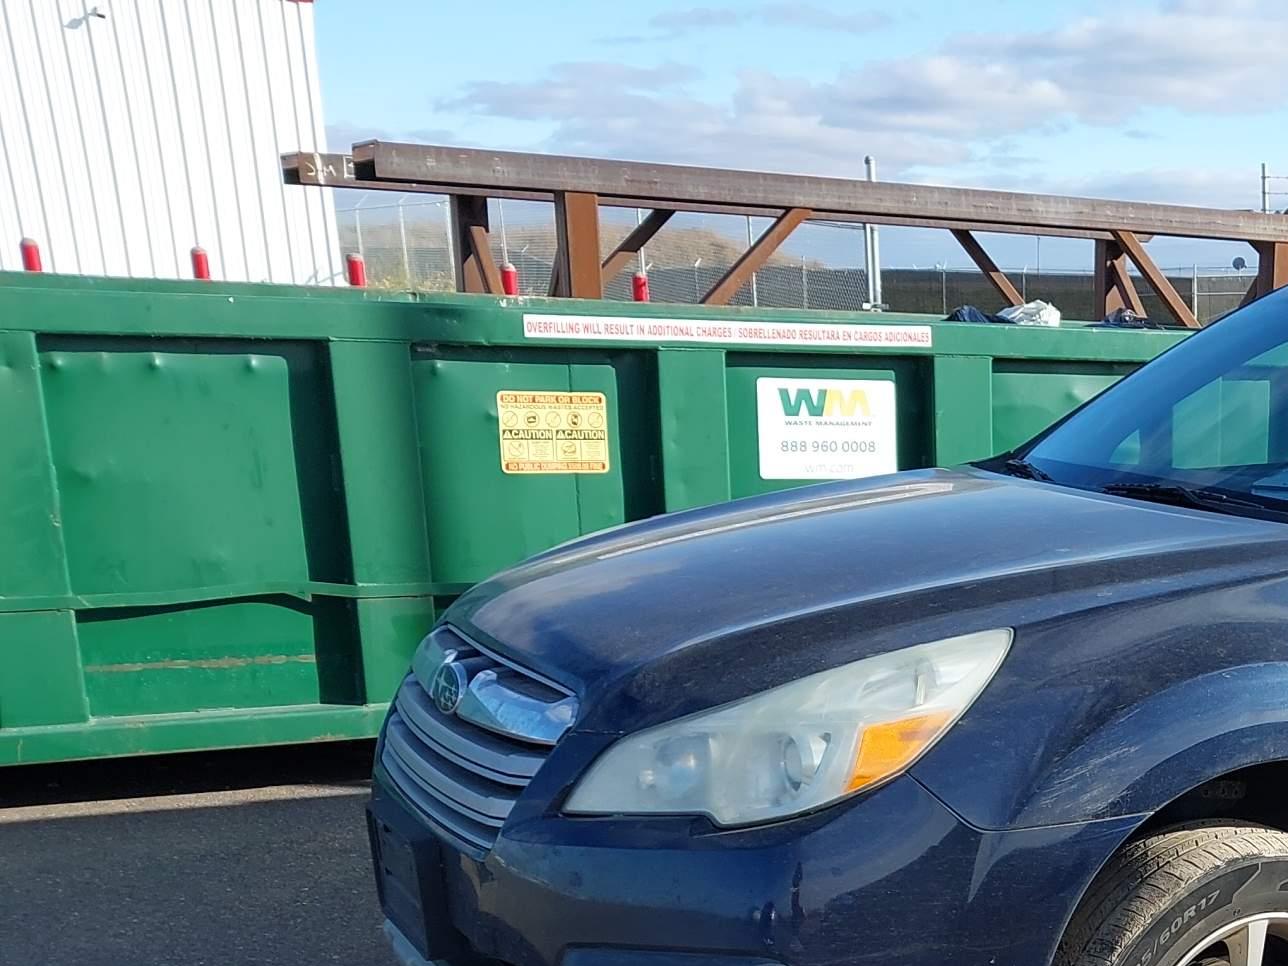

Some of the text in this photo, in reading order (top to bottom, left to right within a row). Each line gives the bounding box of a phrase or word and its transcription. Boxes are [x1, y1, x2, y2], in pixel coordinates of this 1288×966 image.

[527, 322, 580, 335] OVERFILLING
[582, 323, 602, 335] WILL
[604, 324, 634, 336] RESULT
[637, 325, 645, 336] IN
[648, 325, 694, 337] ADDITIONAL
[697, 326, 732, 338] CHARGES
[738, 327, 797, 340] SOBRELLENADO
[842, 331, 852, 341] EN
[854, 331, 882, 342] CARGOS
[885, 331, 930, 343] ADICIONALES
[503, 395, 515, 403] DO
[516, 395, 533, 403] NOT
[558, 396, 571, 404] OR
[572, 396, 600, 404] BLOCK
[777, 388, 872, 417] WM
[512, 430, 552, 439] CAUTION
[566, 431, 604, 440] CAUTION
[781, 441, 876, 453] 888 960 0008
